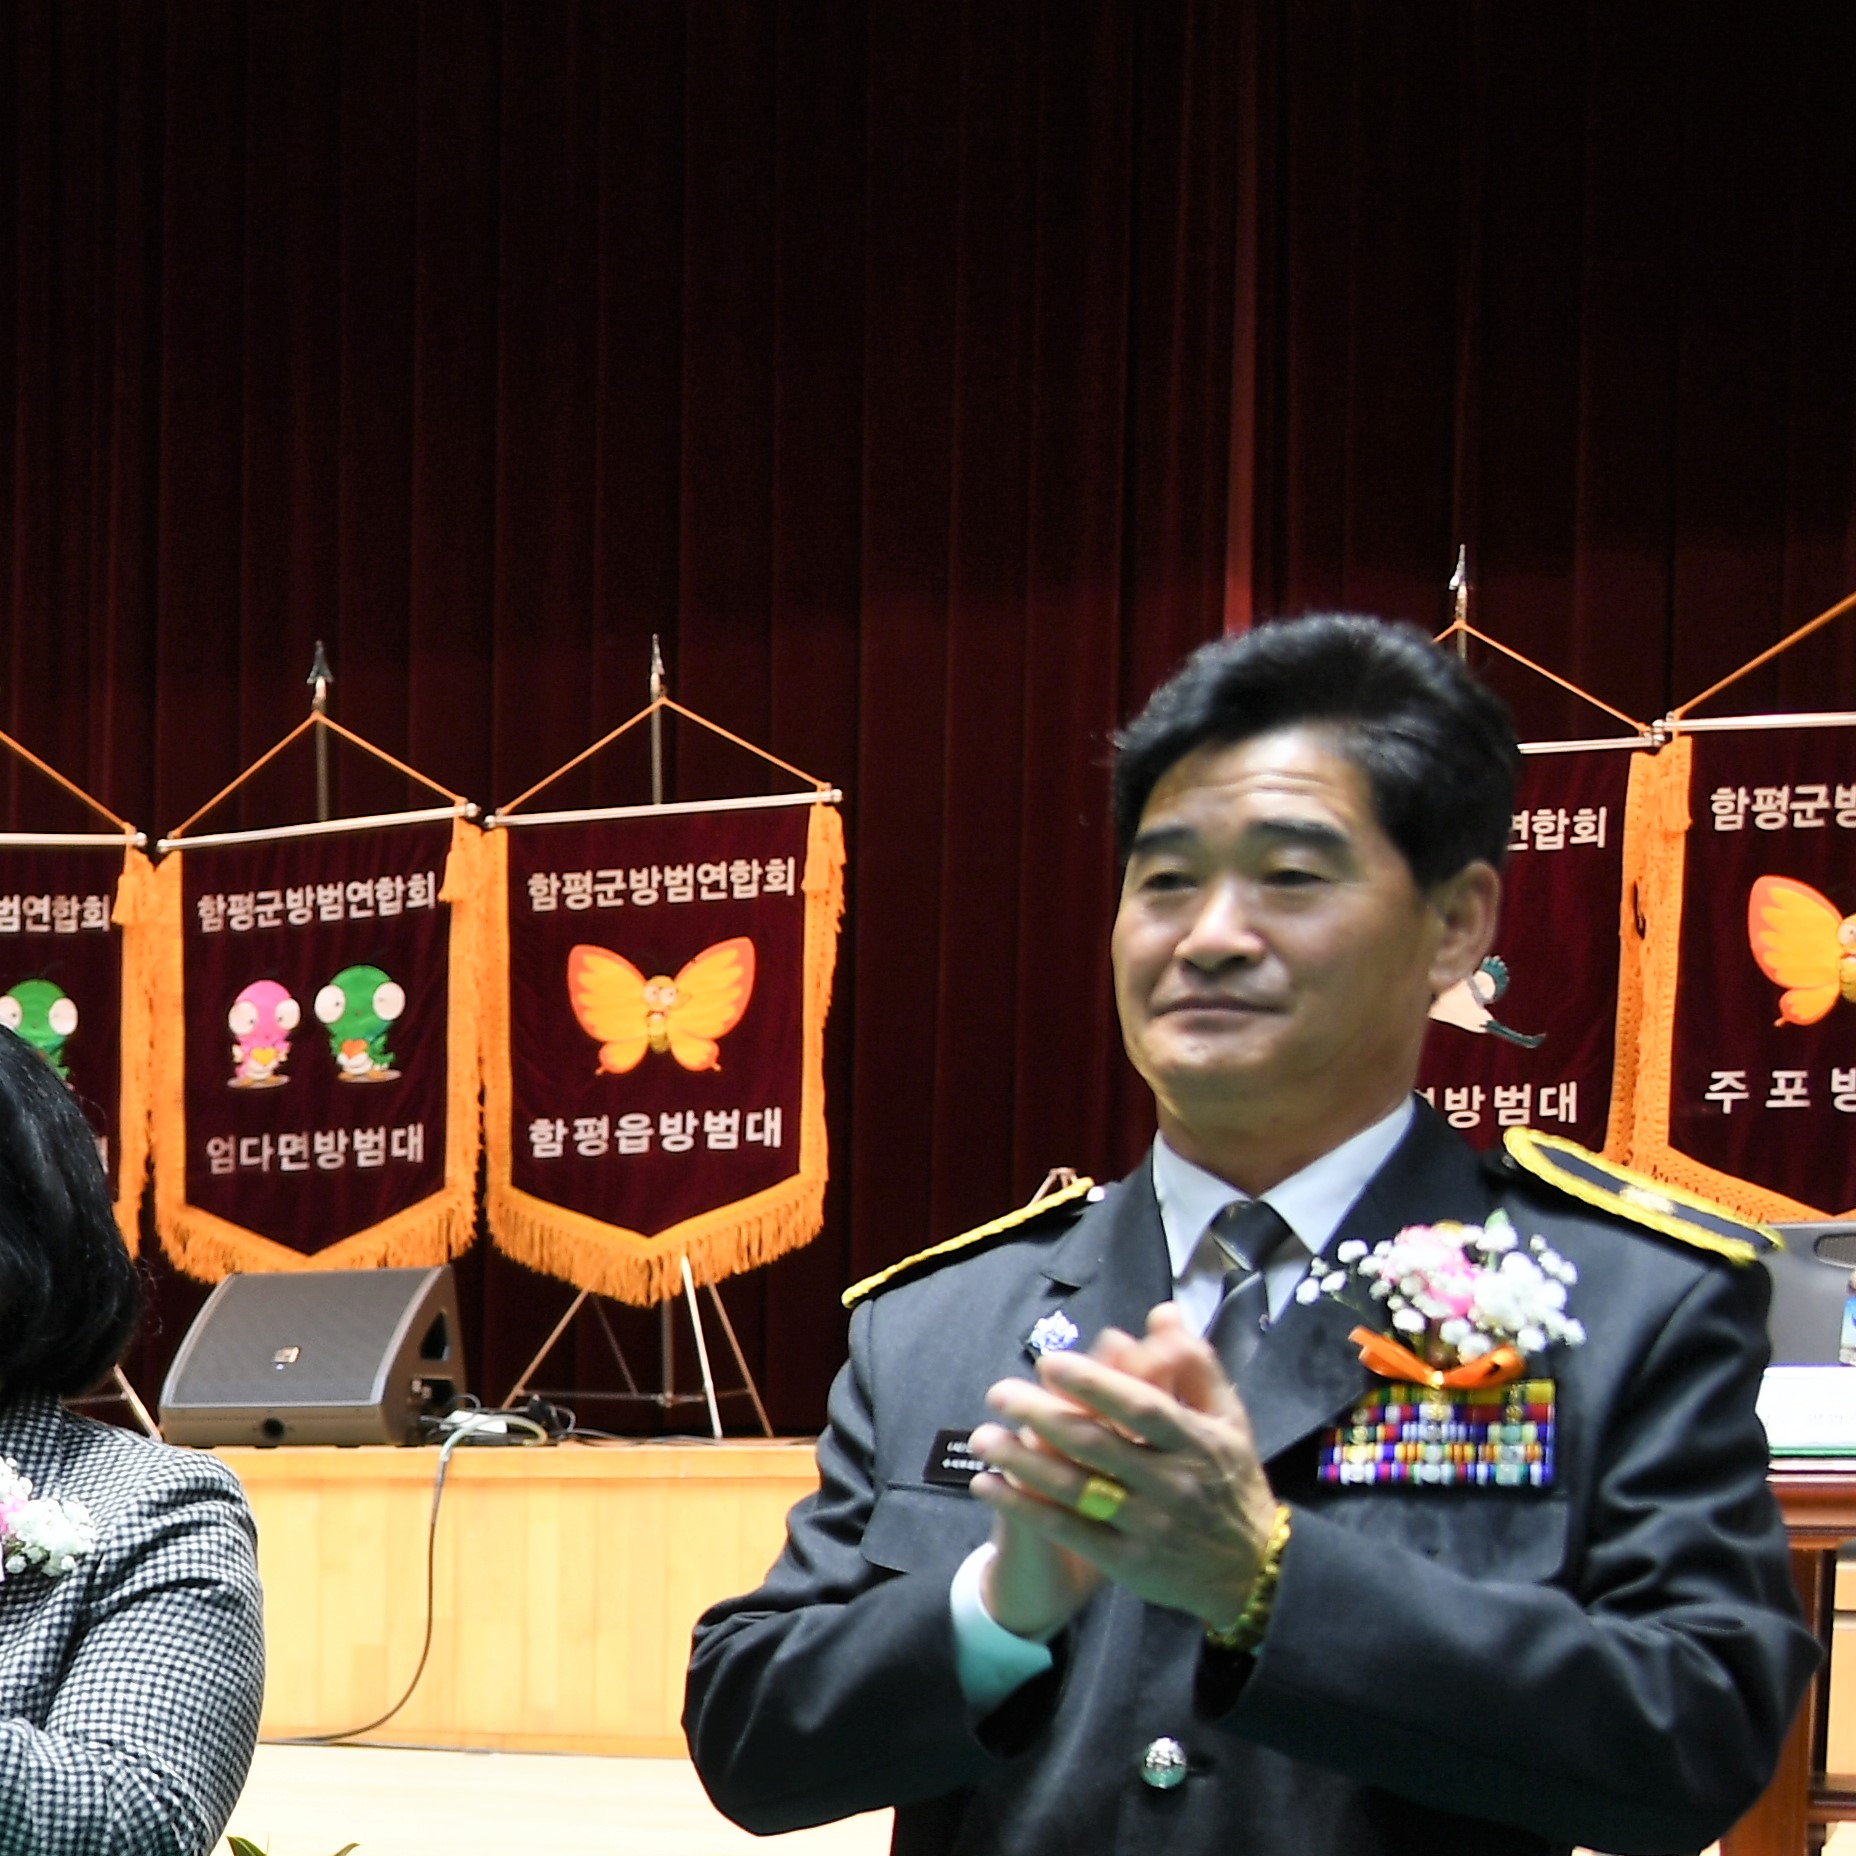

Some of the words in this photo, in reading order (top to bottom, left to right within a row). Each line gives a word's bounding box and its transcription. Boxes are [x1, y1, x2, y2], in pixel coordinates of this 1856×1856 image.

[197, 871, 436, 933] 함평군방범연합회
[527, 857, 796, 913] 함평군방범연합회
[1416, 1081, 1578, 1129] 방범대
[206, 1122, 424, 1175] 엄다면방범대
[528, 1107, 783, 1159] 함평읍방범대
